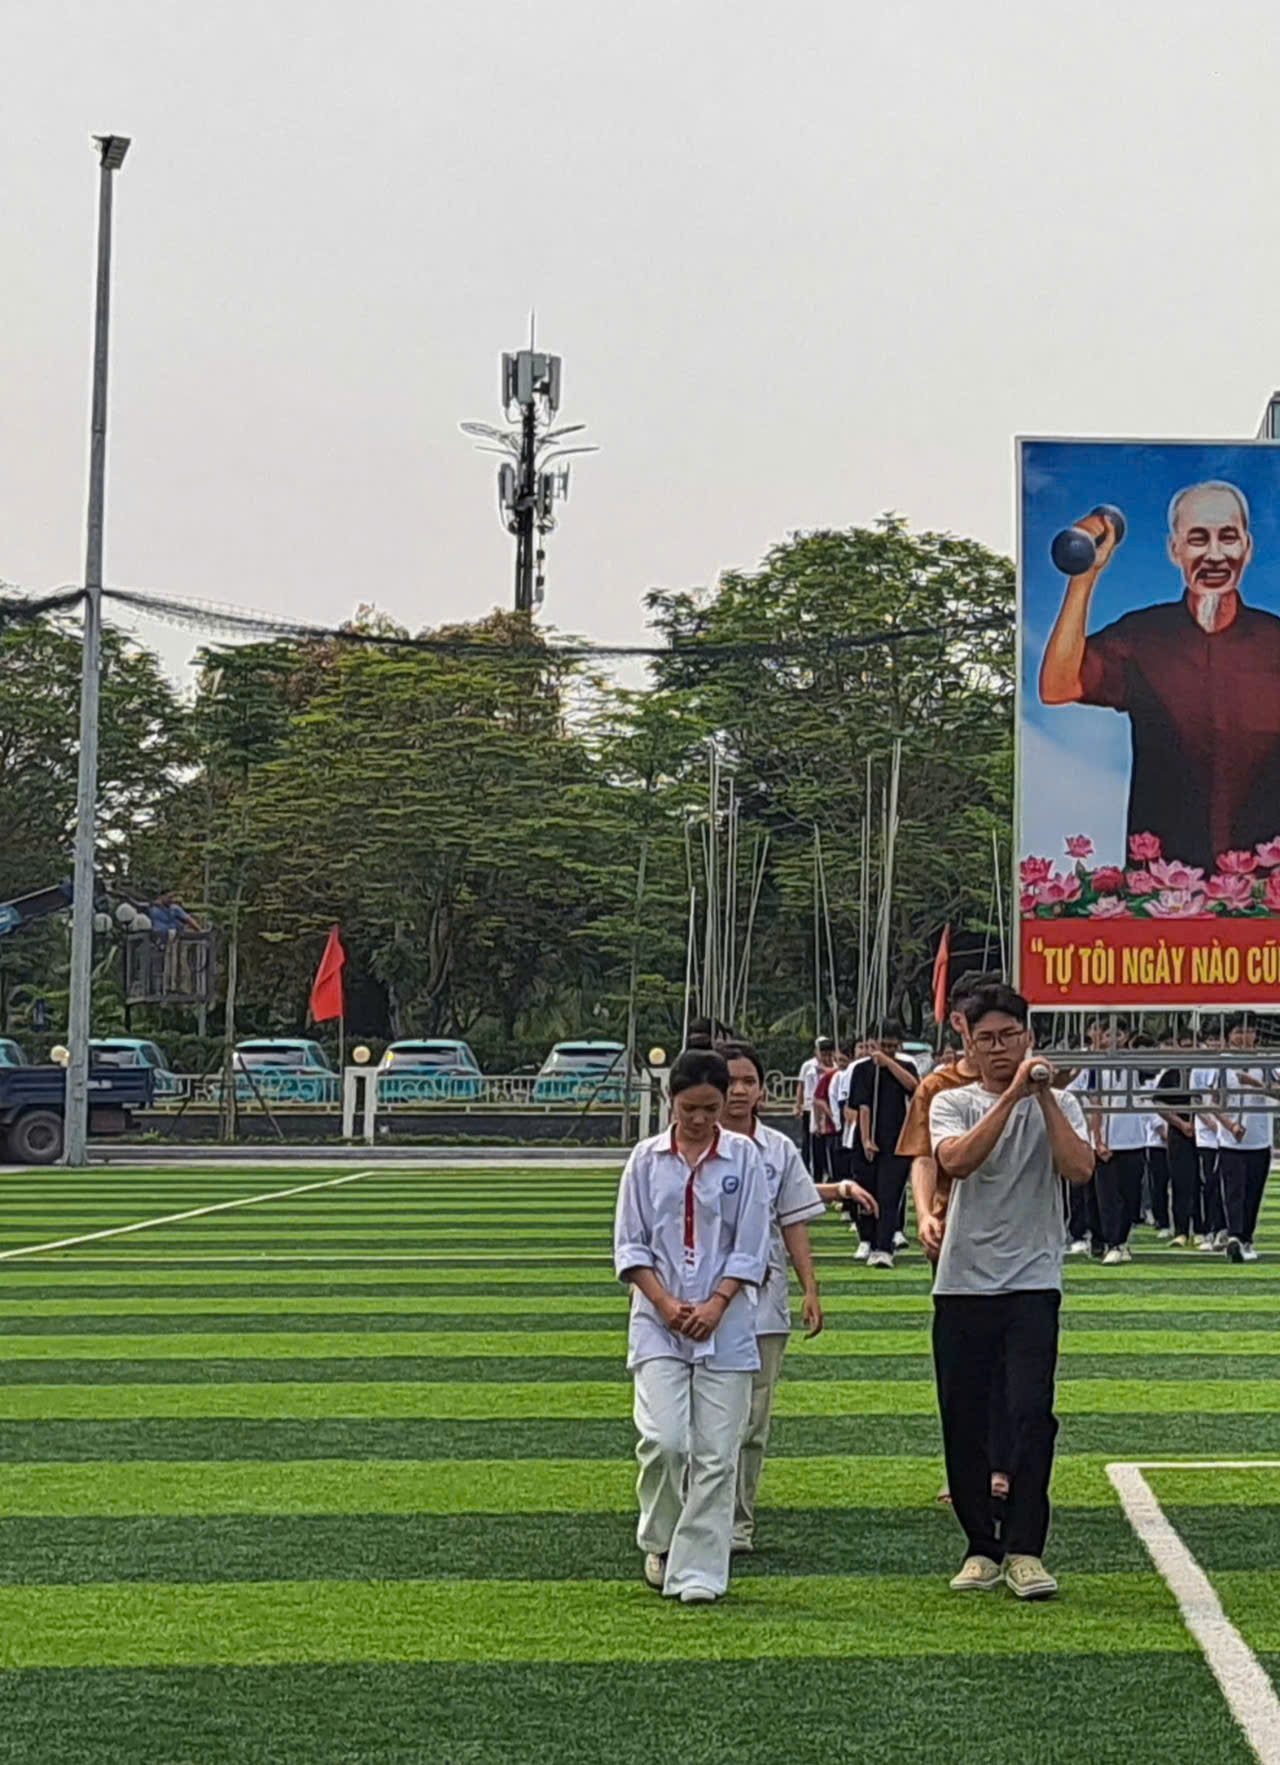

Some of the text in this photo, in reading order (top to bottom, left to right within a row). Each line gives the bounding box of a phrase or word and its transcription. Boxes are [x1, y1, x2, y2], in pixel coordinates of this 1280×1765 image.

[1078, 939, 1115, 985] TÔI
[1122, 939, 1186, 985] NGÀY
[1191, 938, 1240, 985] NÀO
